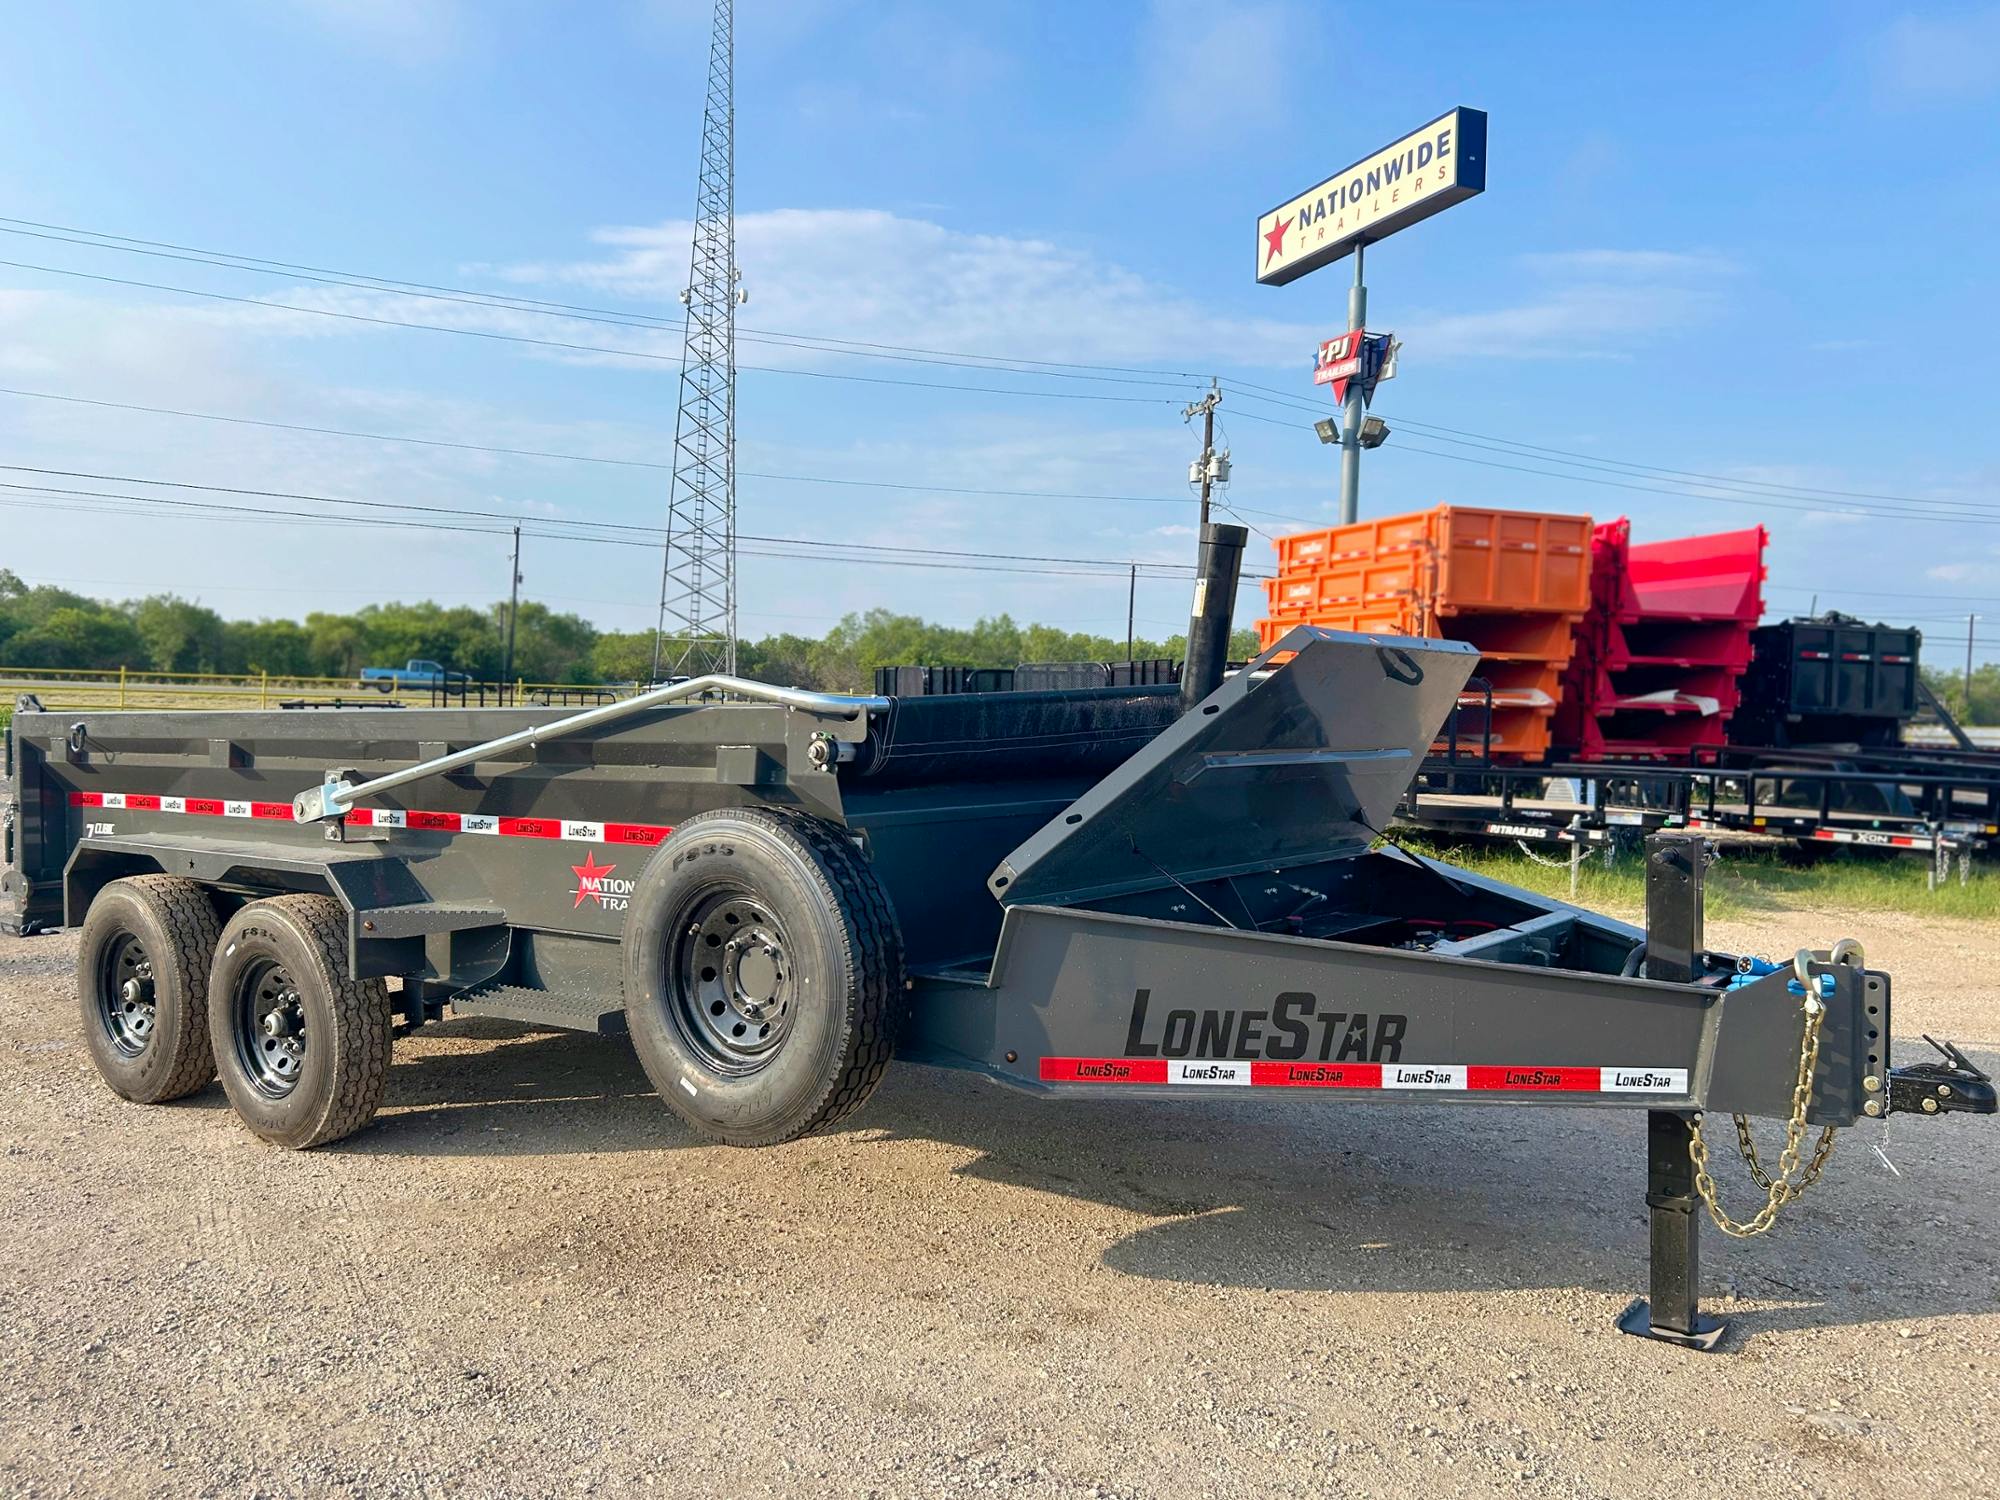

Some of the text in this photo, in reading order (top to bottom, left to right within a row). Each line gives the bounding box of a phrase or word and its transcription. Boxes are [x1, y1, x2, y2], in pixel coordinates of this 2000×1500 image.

[1299, 129, 1451, 231] NATIONWIDE
[1301, 165, 1446, 249] TRAILERS
[1326, 336, 1350, 363] PJ
[86, 823, 95, 838] 7
[1076, 1062, 1131, 1078] LONESTAR
[1182, 1064, 1236, 1080] LONESTAR
[1288, 1066, 1344, 1082] LONESTAR
[1396, 1069, 1452, 1085] LONESTAR
[1505, 1070, 1561, 1086] LONESTAR
[1615, 1072, 1671, 1088] LONESTAR
